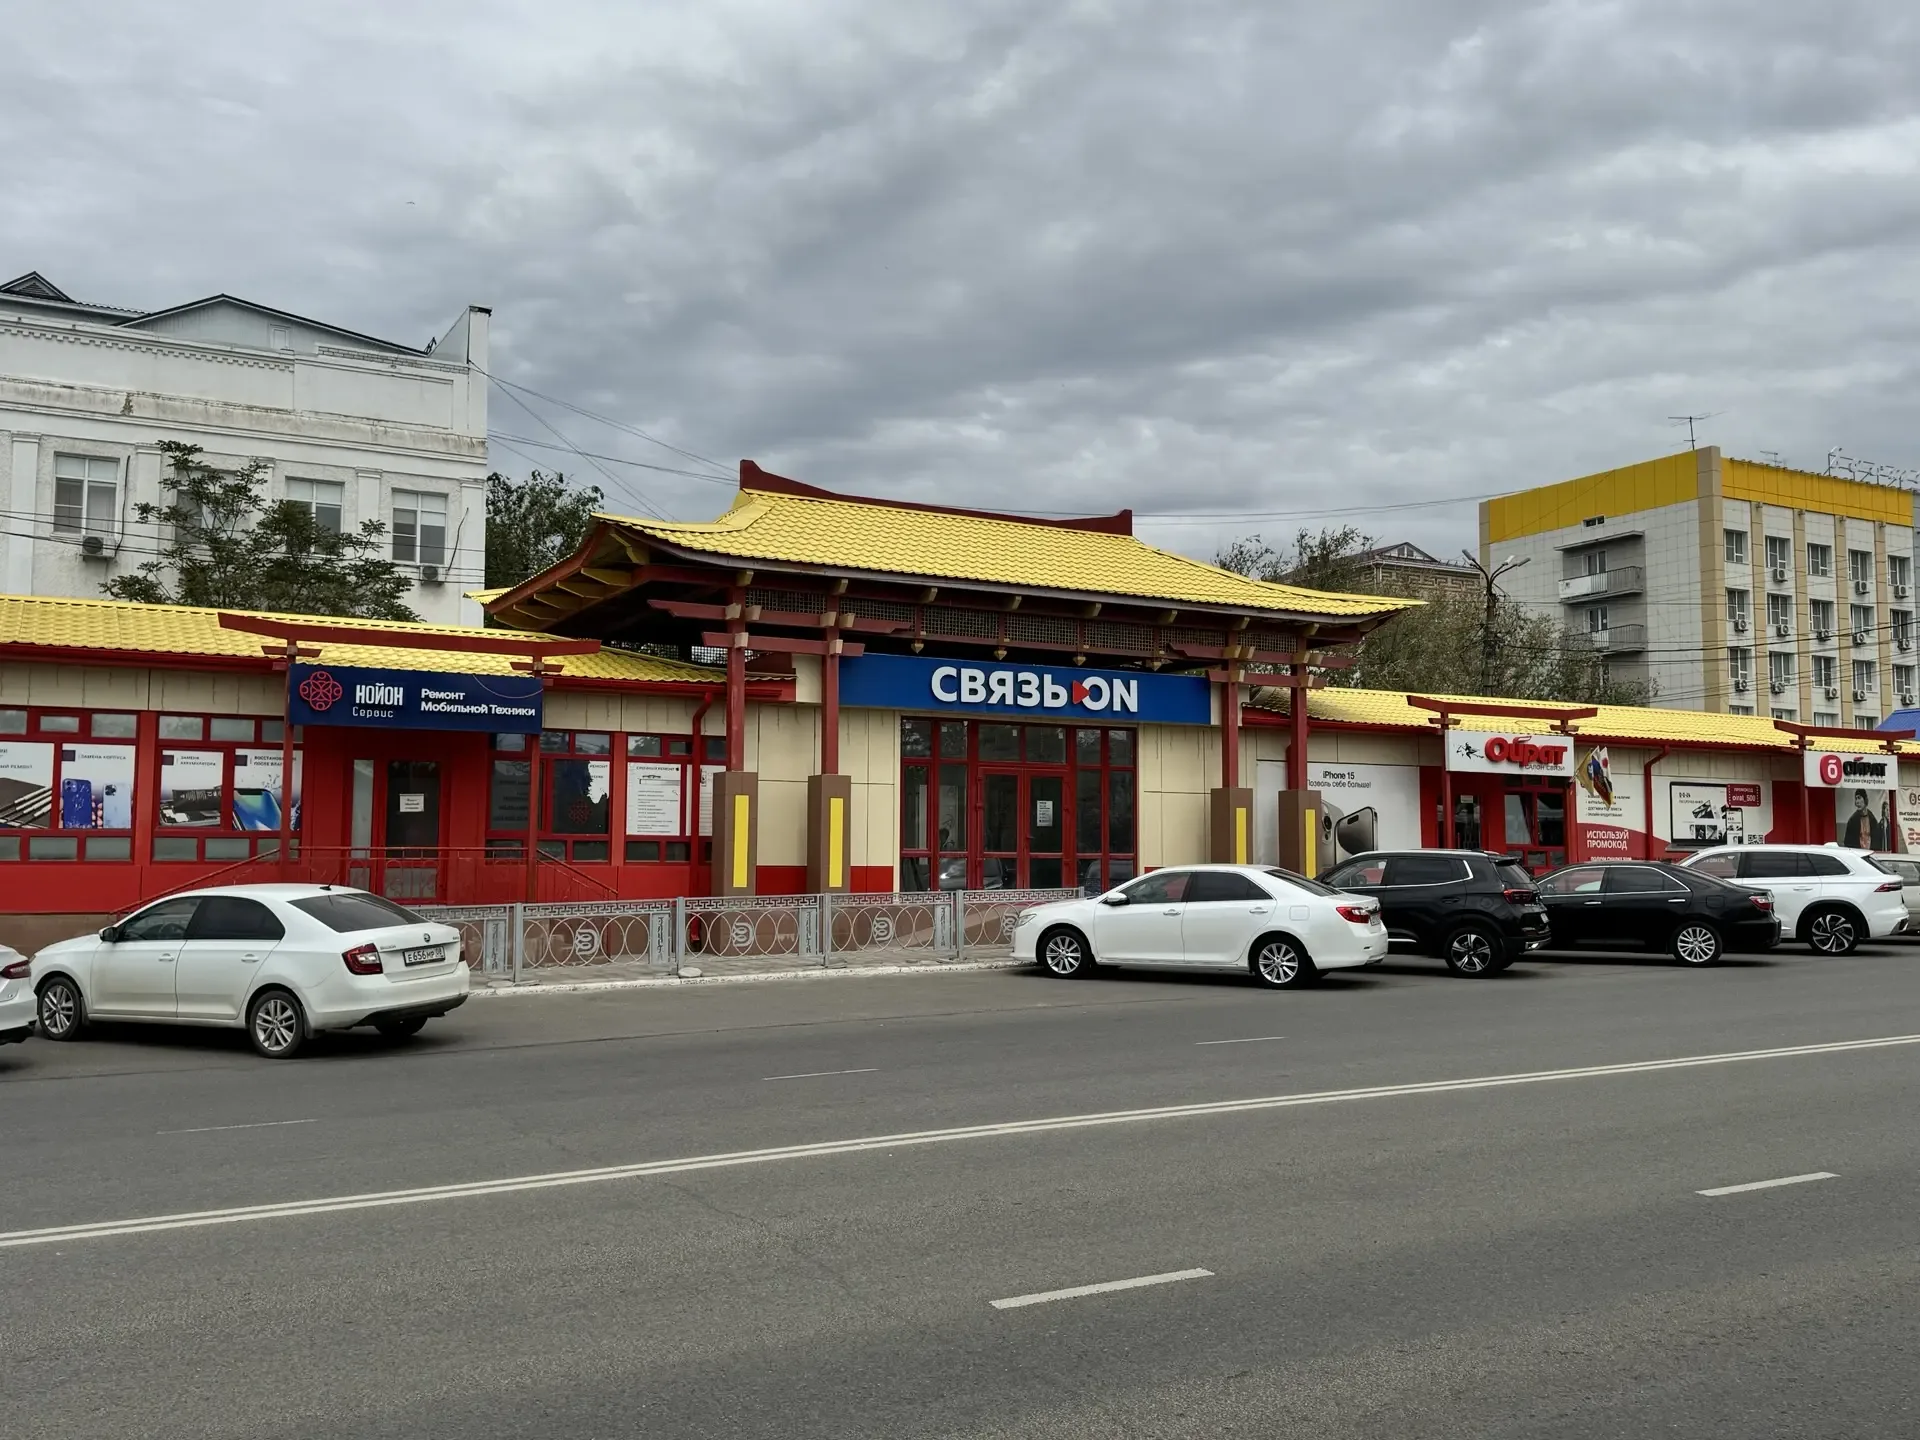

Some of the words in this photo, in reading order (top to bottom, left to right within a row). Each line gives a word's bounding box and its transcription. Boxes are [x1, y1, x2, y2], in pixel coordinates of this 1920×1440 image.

[355, 682, 404, 706] НОЙОН
[420, 688, 466, 701] Ремонт
[352, 706, 394, 719] Сервис
[420, 701, 489, 715] Мобильной
[490, 704, 536, 717] Техники
[1322, 770, 1346, 780] iPhone
[1347, 771, 1355, 780] 15
[1586, 829, 1630, 840] ИСПОЛЬЗУЙ
[1586, 839, 1628, 851] ПРОМОКОД
